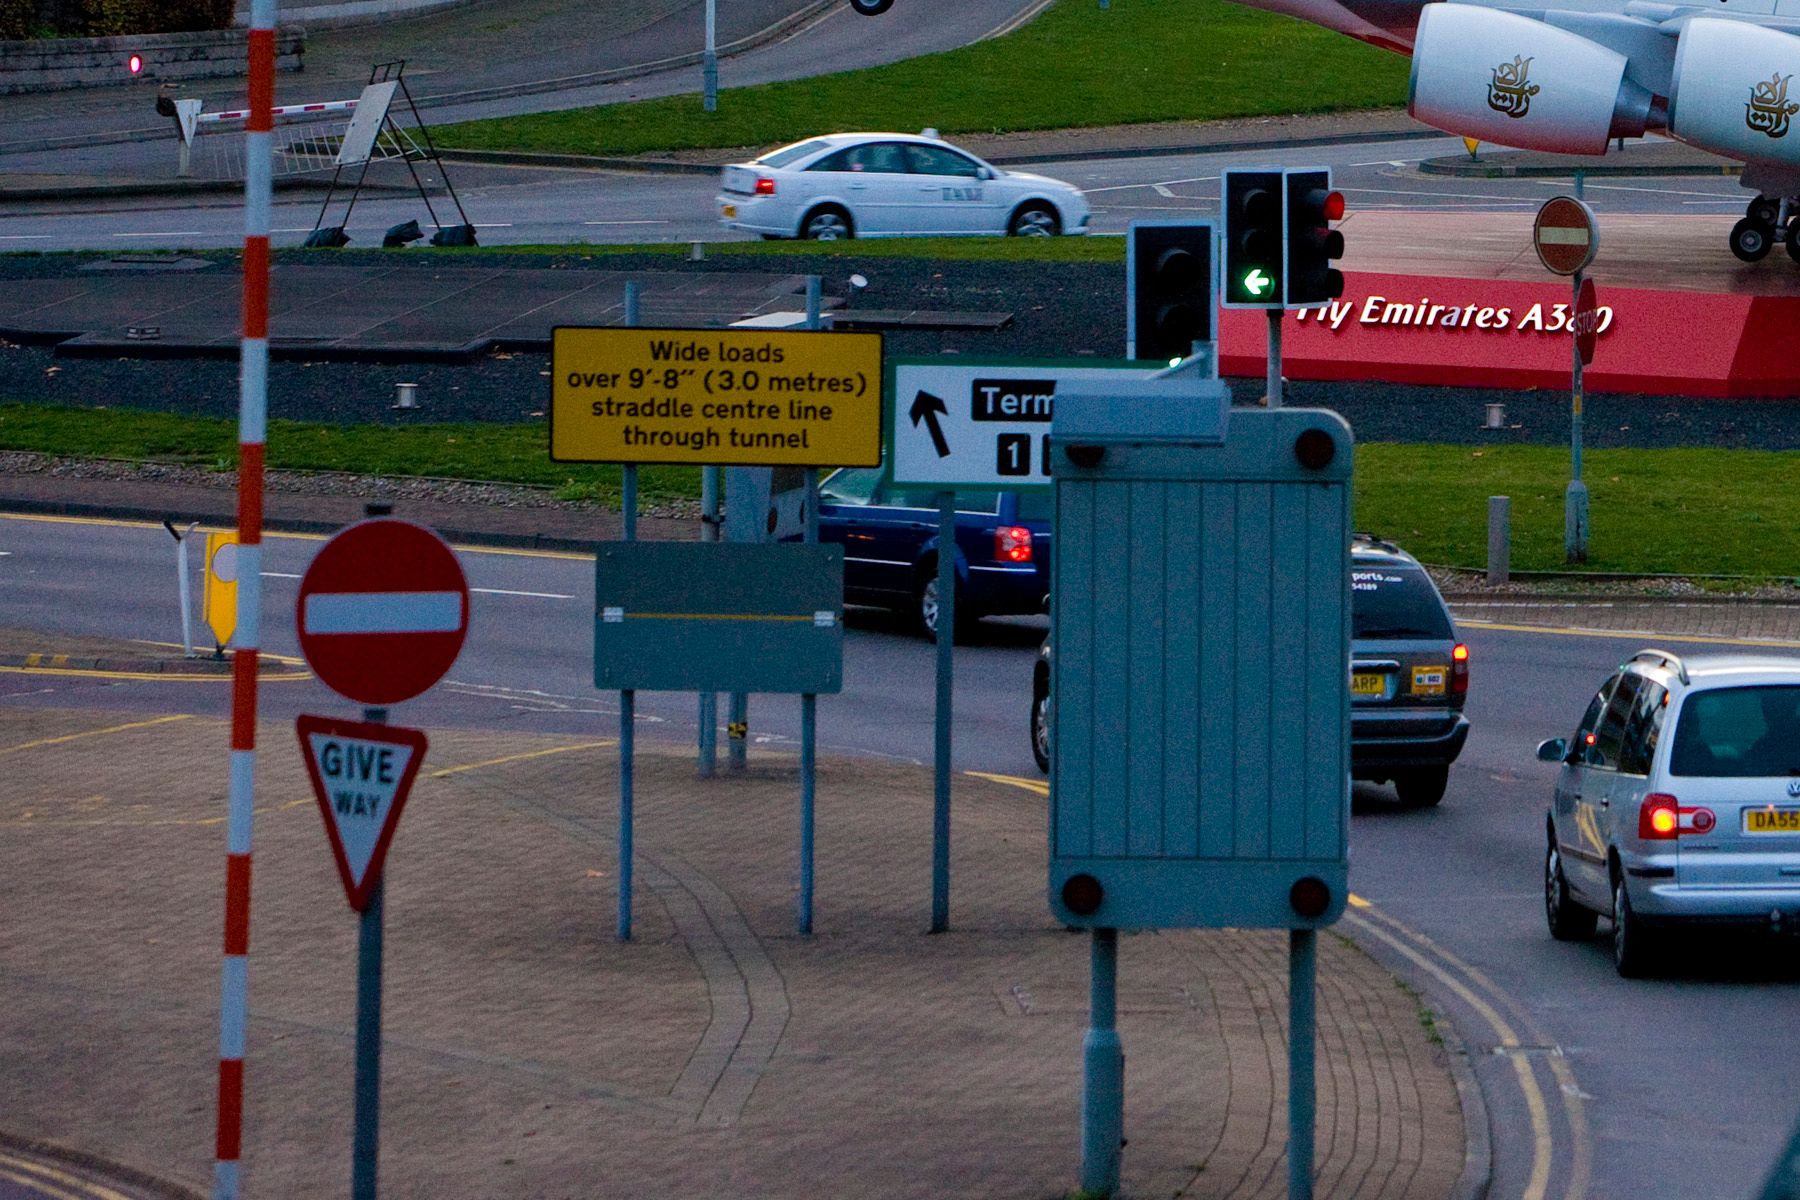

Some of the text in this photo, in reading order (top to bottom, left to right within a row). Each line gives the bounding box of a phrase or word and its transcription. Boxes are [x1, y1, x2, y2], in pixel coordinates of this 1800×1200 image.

[1360, 296, 1510, 331] Emirates
[649, 340, 785, 363] Wide loads
[567, 371, 618, 388] over
[768, 372, 867, 396] metres)
[591, 397, 832, 420] straddle centre line
[980, 386, 1054, 415] Term
[623, 425, 809, 450] through tunnel
[1007, 441, 1018, 469] 1
[322, 741, 394, 784] GIVE
[333, 790, 381, 817] WAY
[1755, 809, 1799, 827] DA55
